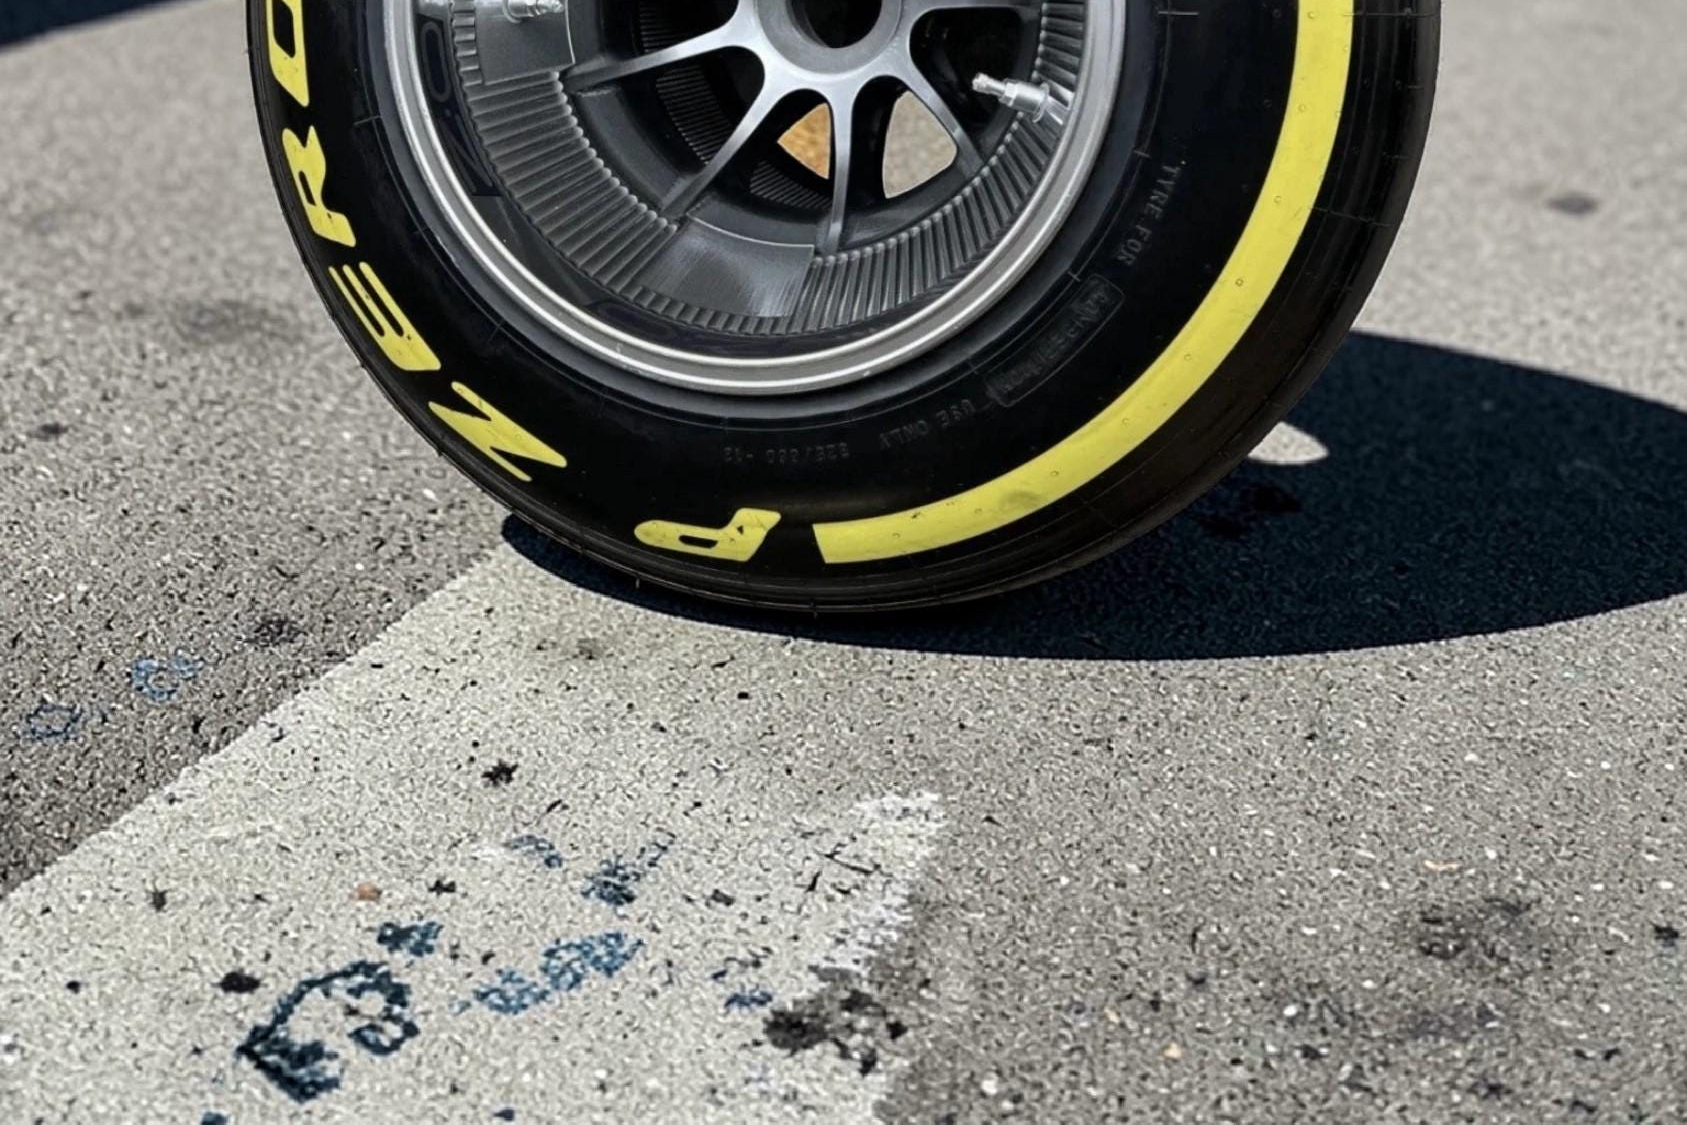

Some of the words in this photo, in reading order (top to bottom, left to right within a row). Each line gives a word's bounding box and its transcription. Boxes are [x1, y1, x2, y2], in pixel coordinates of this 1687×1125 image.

[1150, 164, 1180, 218] TYRE
[1115, 225, 1154, 267] FOR
[879, 418, 930, 448] ONLY
[939, 398, 978, 427] USE
[634, 507, 781, 563] P
